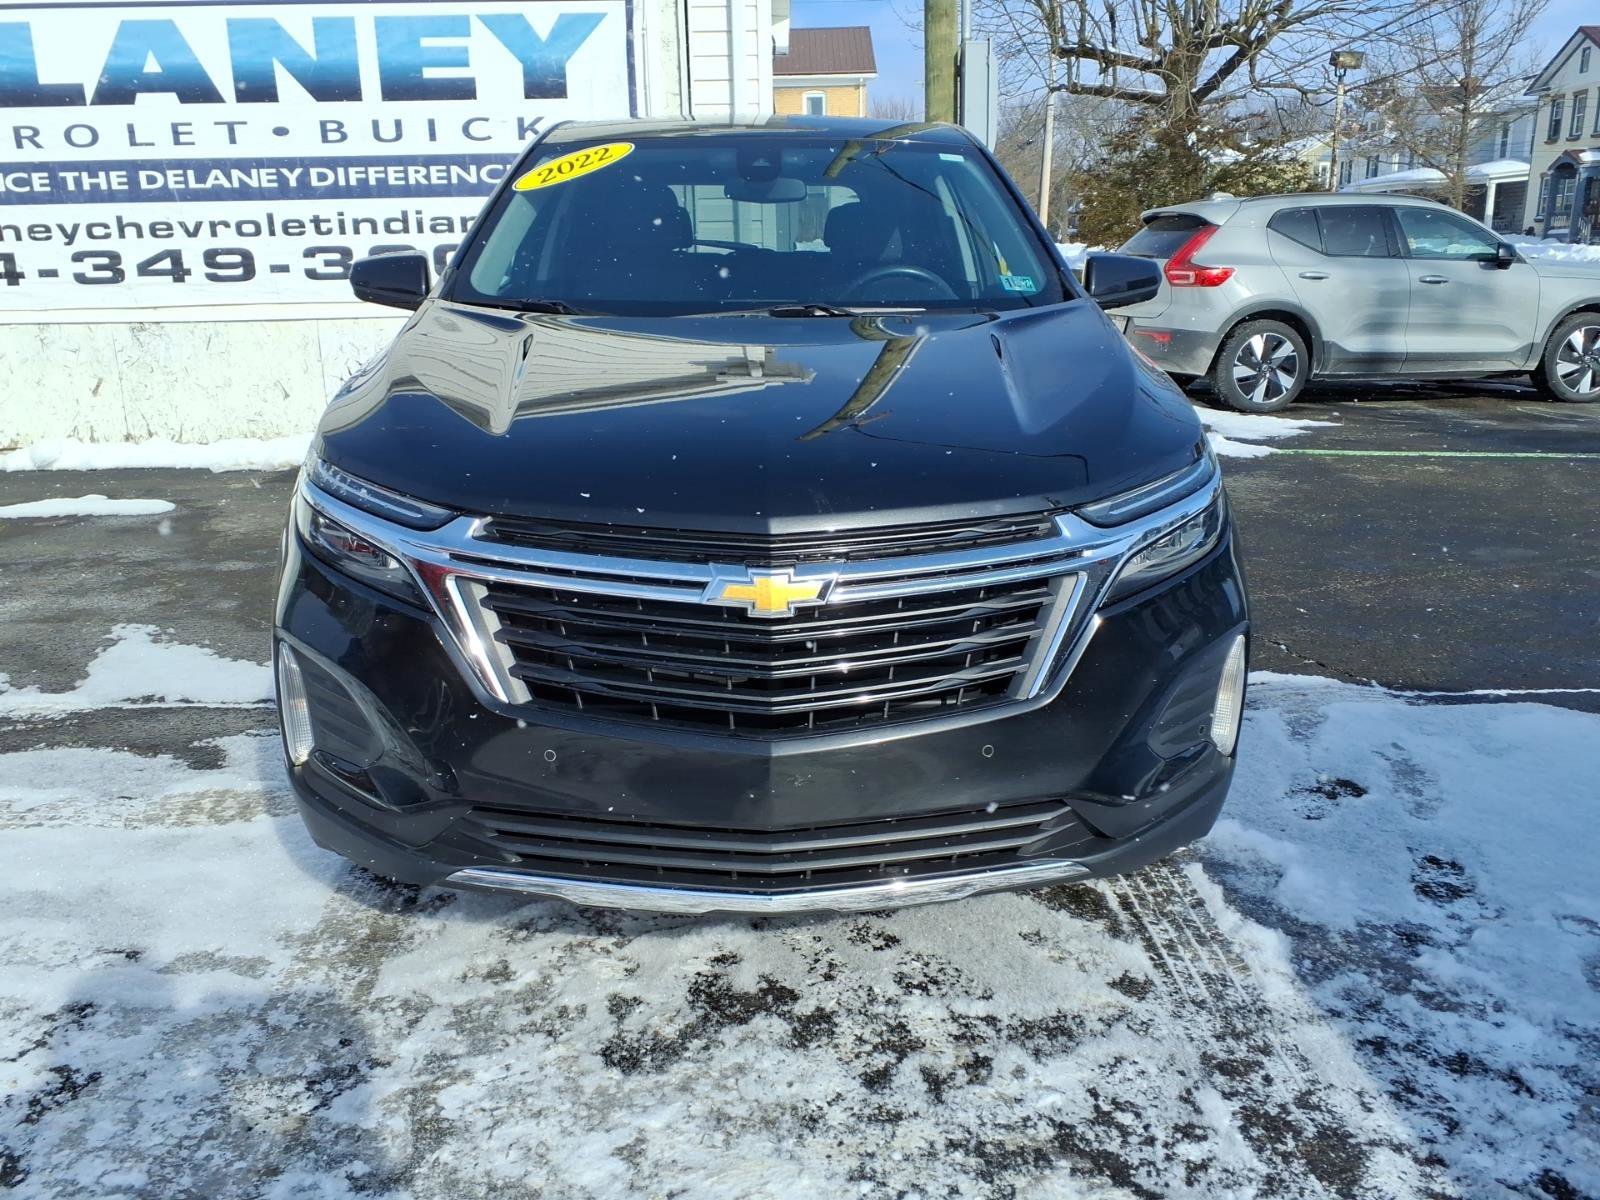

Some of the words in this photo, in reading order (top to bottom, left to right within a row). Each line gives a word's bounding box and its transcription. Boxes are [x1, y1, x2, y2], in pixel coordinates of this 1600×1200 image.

[0, 12, 608, 107] LANEY
[12, 120, 248, 150] ROLET
[318, 116, 545, 145] BUICK
[0, 172, 51, 193] CE
[58, 170, 129, 192] THE
[138, 167, 304, 191] DELANEY
[309, 164, 512, 187] DIFFERENC
[537, 146, 613, 184] 2022
